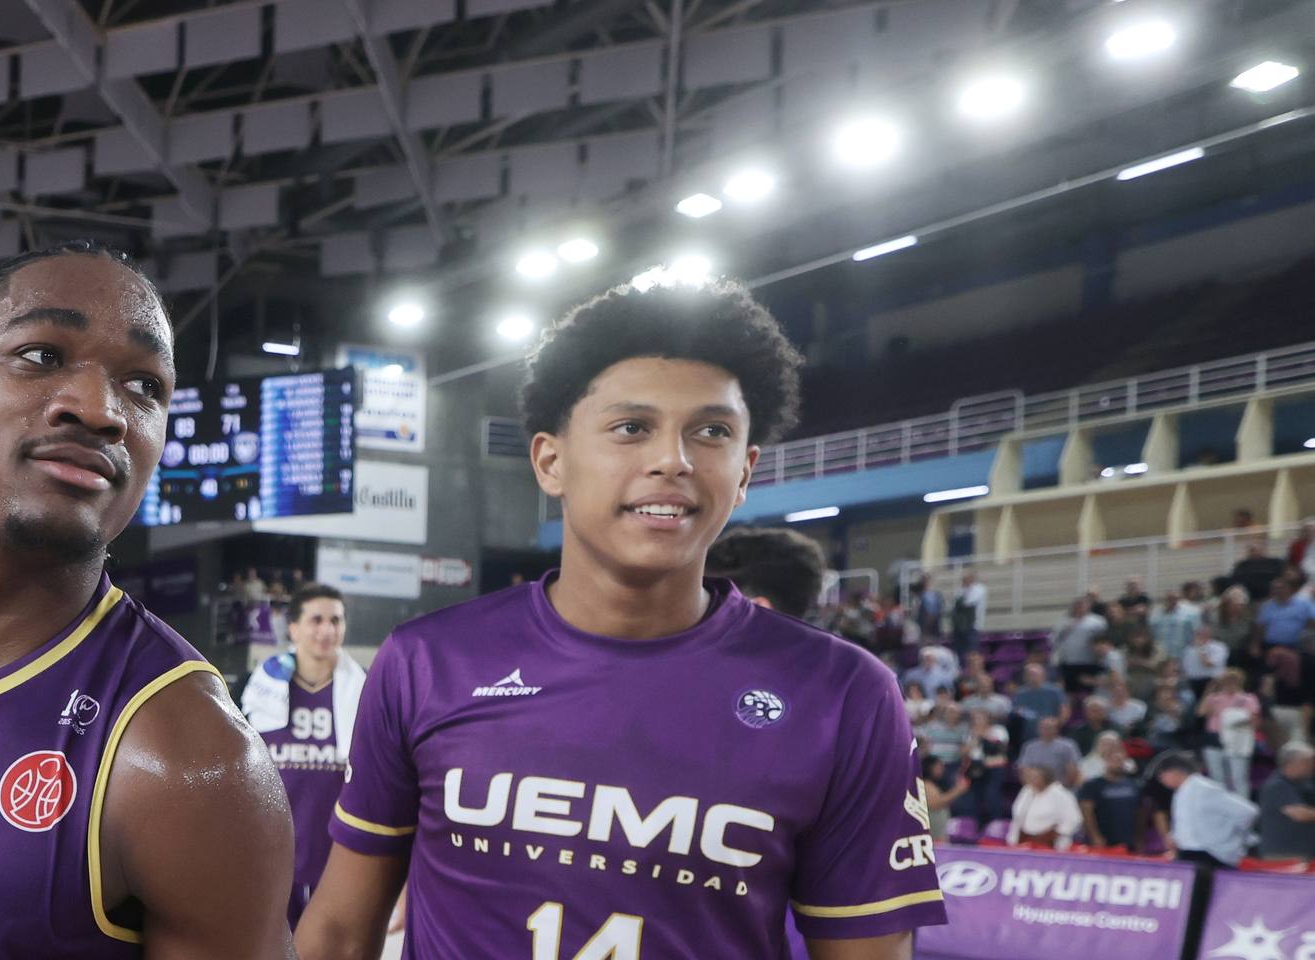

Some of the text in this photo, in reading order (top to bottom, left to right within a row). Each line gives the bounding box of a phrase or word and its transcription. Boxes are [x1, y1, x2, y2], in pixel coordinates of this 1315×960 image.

[472, 686, 542, 697] MERCURY
[291, 707, 333, 740] 99
[444, 768, 775, 868] UEMC
[449, 833, 749, 896] UNIVERSIDAD
[889, 833, 936, 871] CR
[1000, 867, 1183, 909] HYUNDAI
